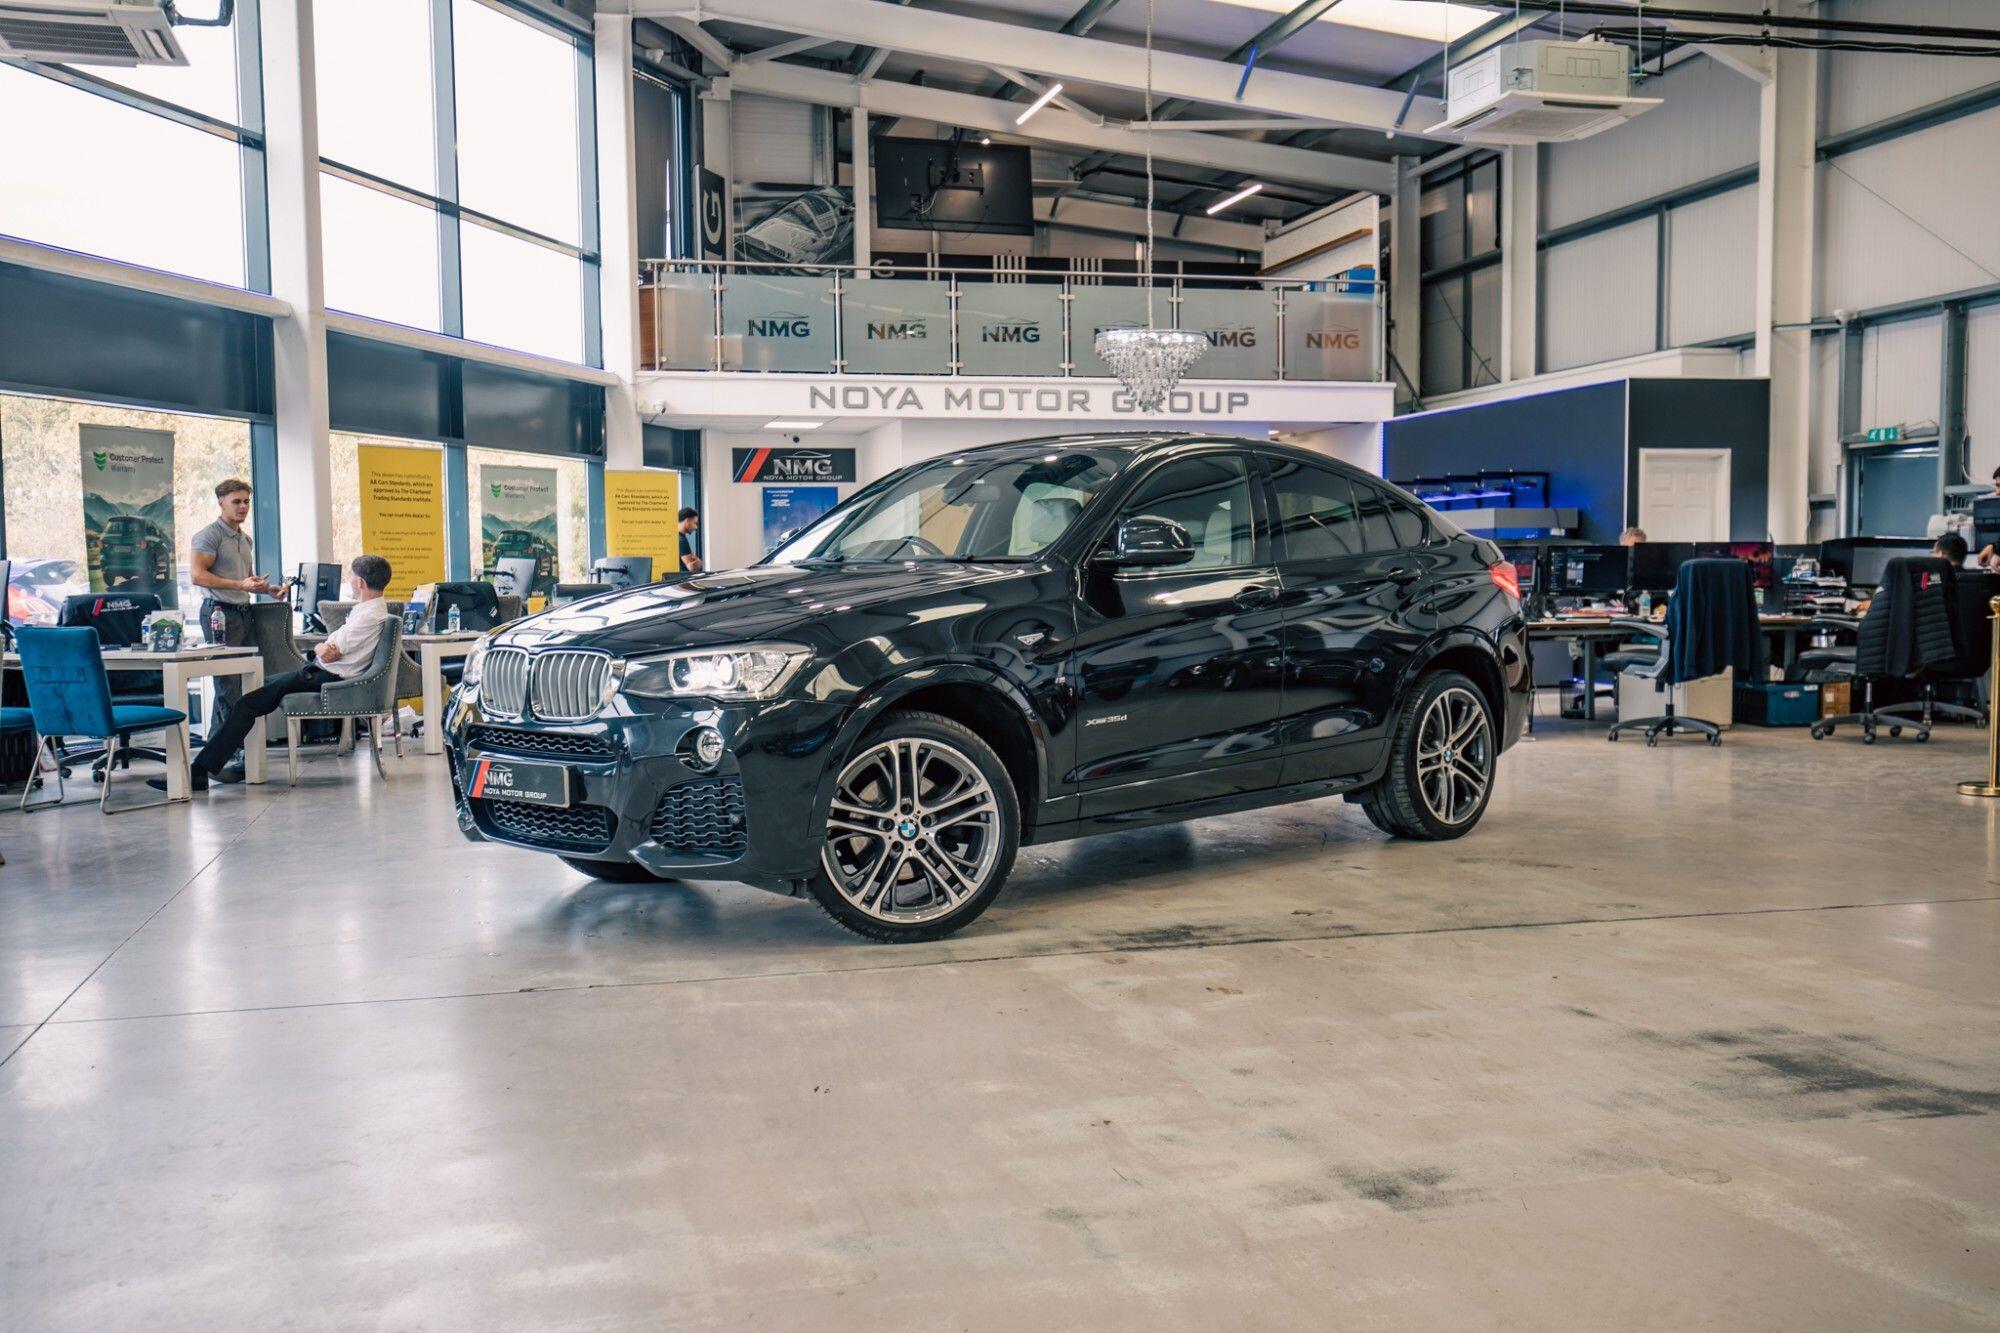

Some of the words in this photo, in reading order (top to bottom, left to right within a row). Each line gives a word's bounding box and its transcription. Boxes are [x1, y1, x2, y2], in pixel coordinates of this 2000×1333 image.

[748, 319, 811, 337] NMG
[867, 323, 927, 339] NMG
[982, 326, 1040, 343] NMG
[1204, 331, 1256, 347] NMG
[1306, 332, 1360, 349] NMG
[810, 385, 924, 410] NOYA
[944, 387, 1091, 412] MOTOR
[772, 459, 833, 475] NMG
[484, 771, 514, 787] NMG
[484, 788, 500, 796] NOYA
[501, 789, 523, 798] MOTOR
[525, 791, 547, 799] GROUP
